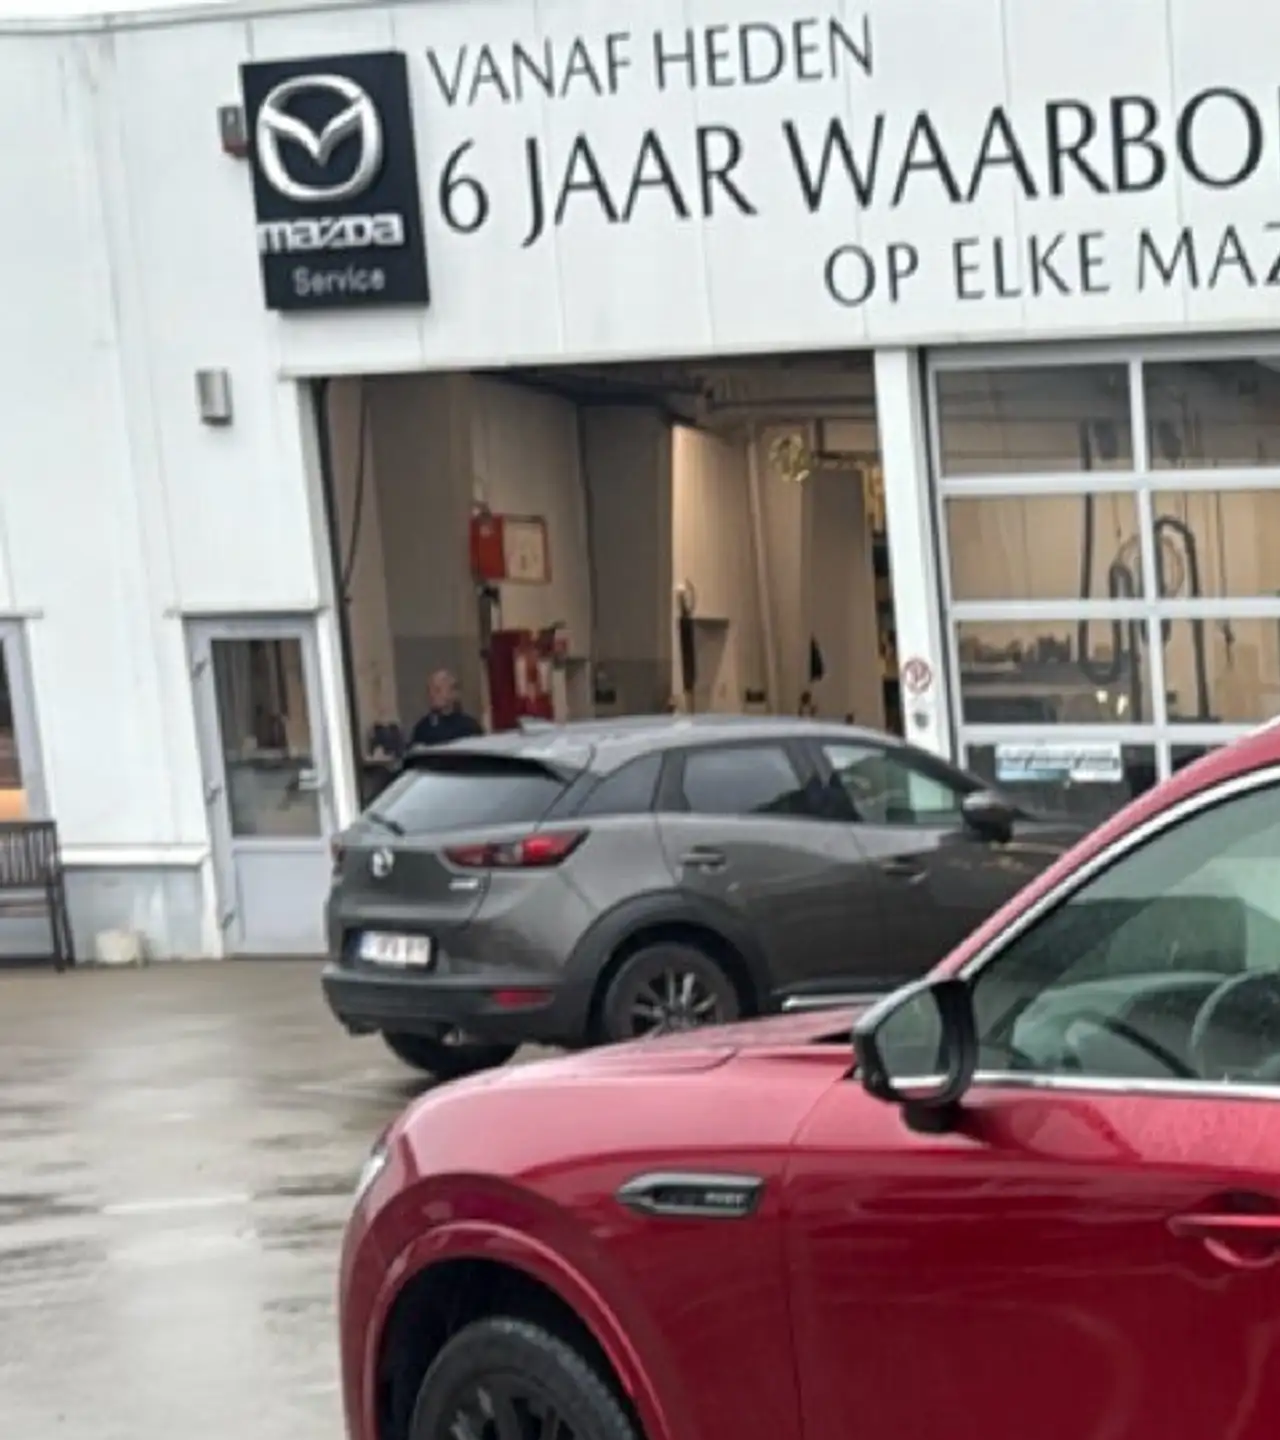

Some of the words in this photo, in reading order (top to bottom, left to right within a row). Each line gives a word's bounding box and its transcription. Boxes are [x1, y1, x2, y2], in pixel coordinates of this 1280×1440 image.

[427, 32, 631, 107] VANAF
[654, 12, 873, 91] HEDEN
[438, 139, 489, 234] 6
[521, 125, 758, 248] JAAR
[256, 212, 404, 255] mazda
[824, 241, 919, 307] OP
[952, 230, 1111, 300] ELKE
[293, 263, 386, 296] Service
